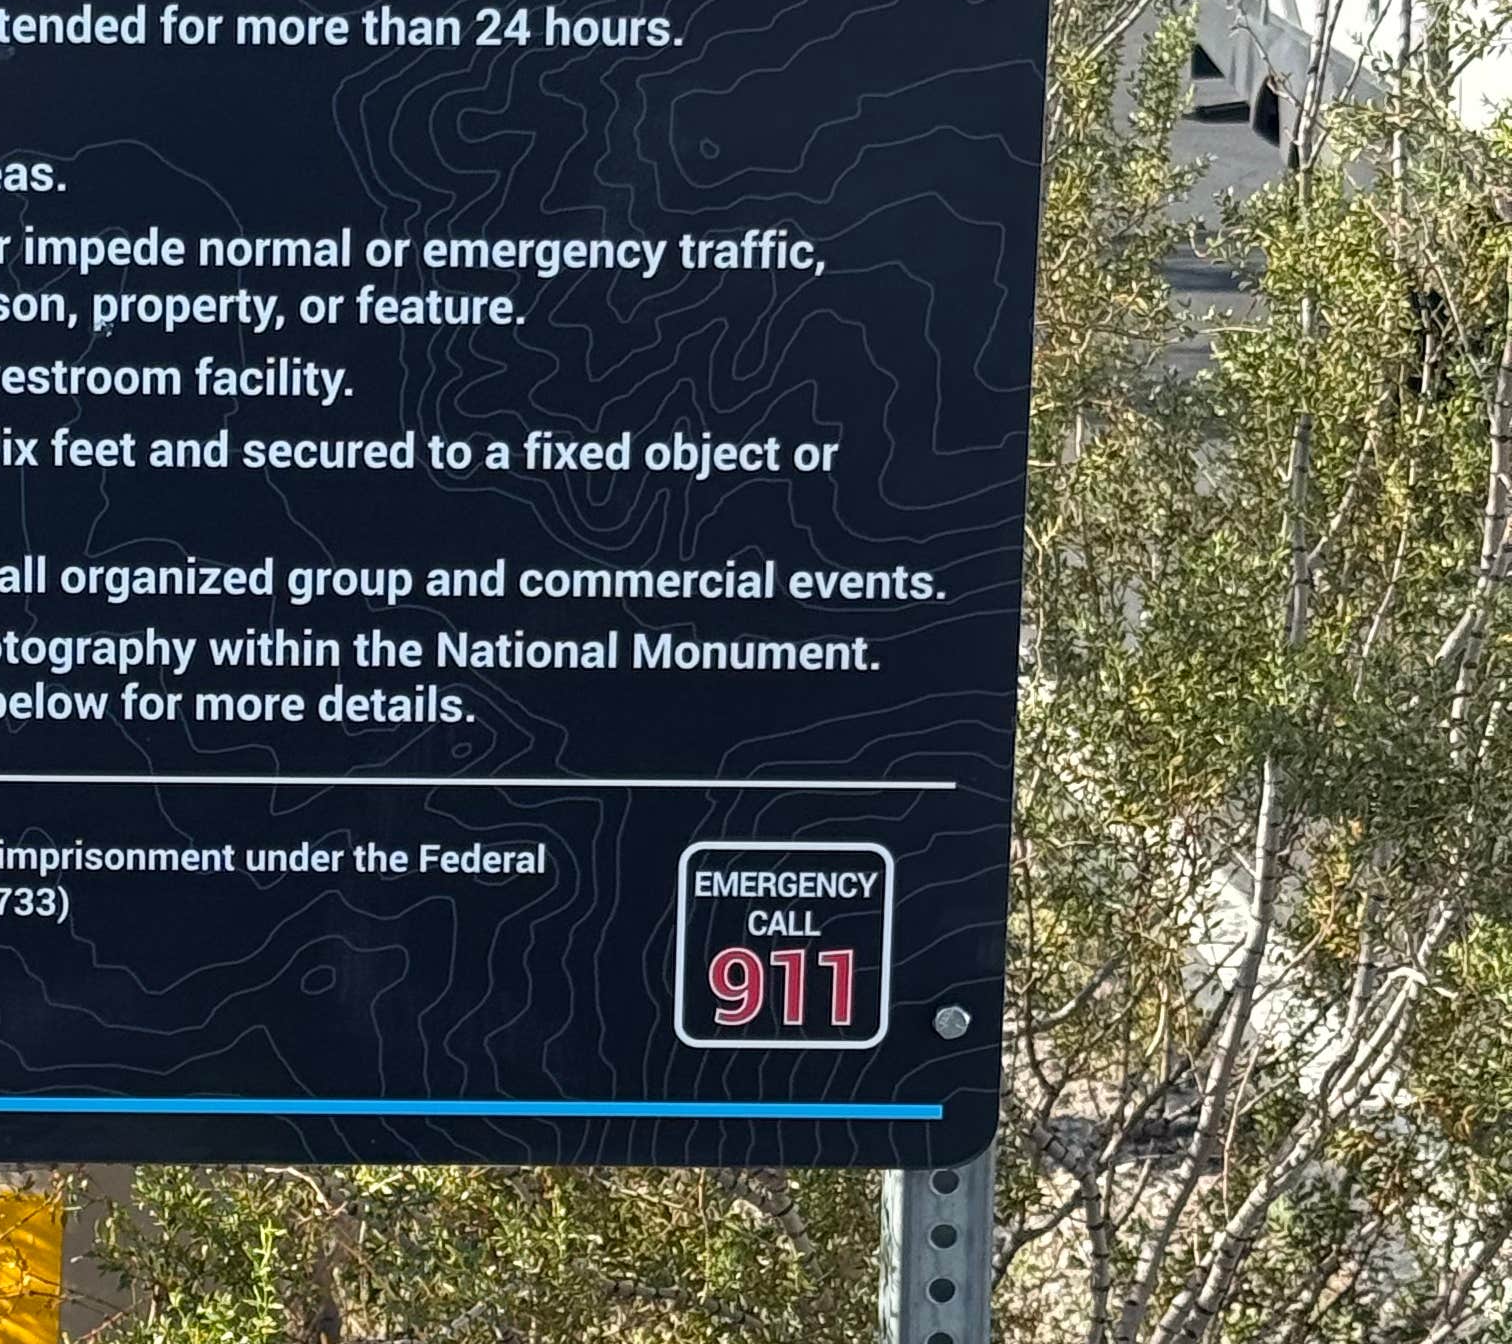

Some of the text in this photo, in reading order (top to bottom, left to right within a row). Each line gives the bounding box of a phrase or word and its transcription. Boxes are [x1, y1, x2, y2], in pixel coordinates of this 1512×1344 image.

[120, 680, 183, 722] for
[195, 692, 305, 723] more
[318, 682, 475, 723] details.
[694, 870, 878, 899] EMERGENCY
[748, 909, 821, 937] CALL
[708, 946, 854, 1027] 911
